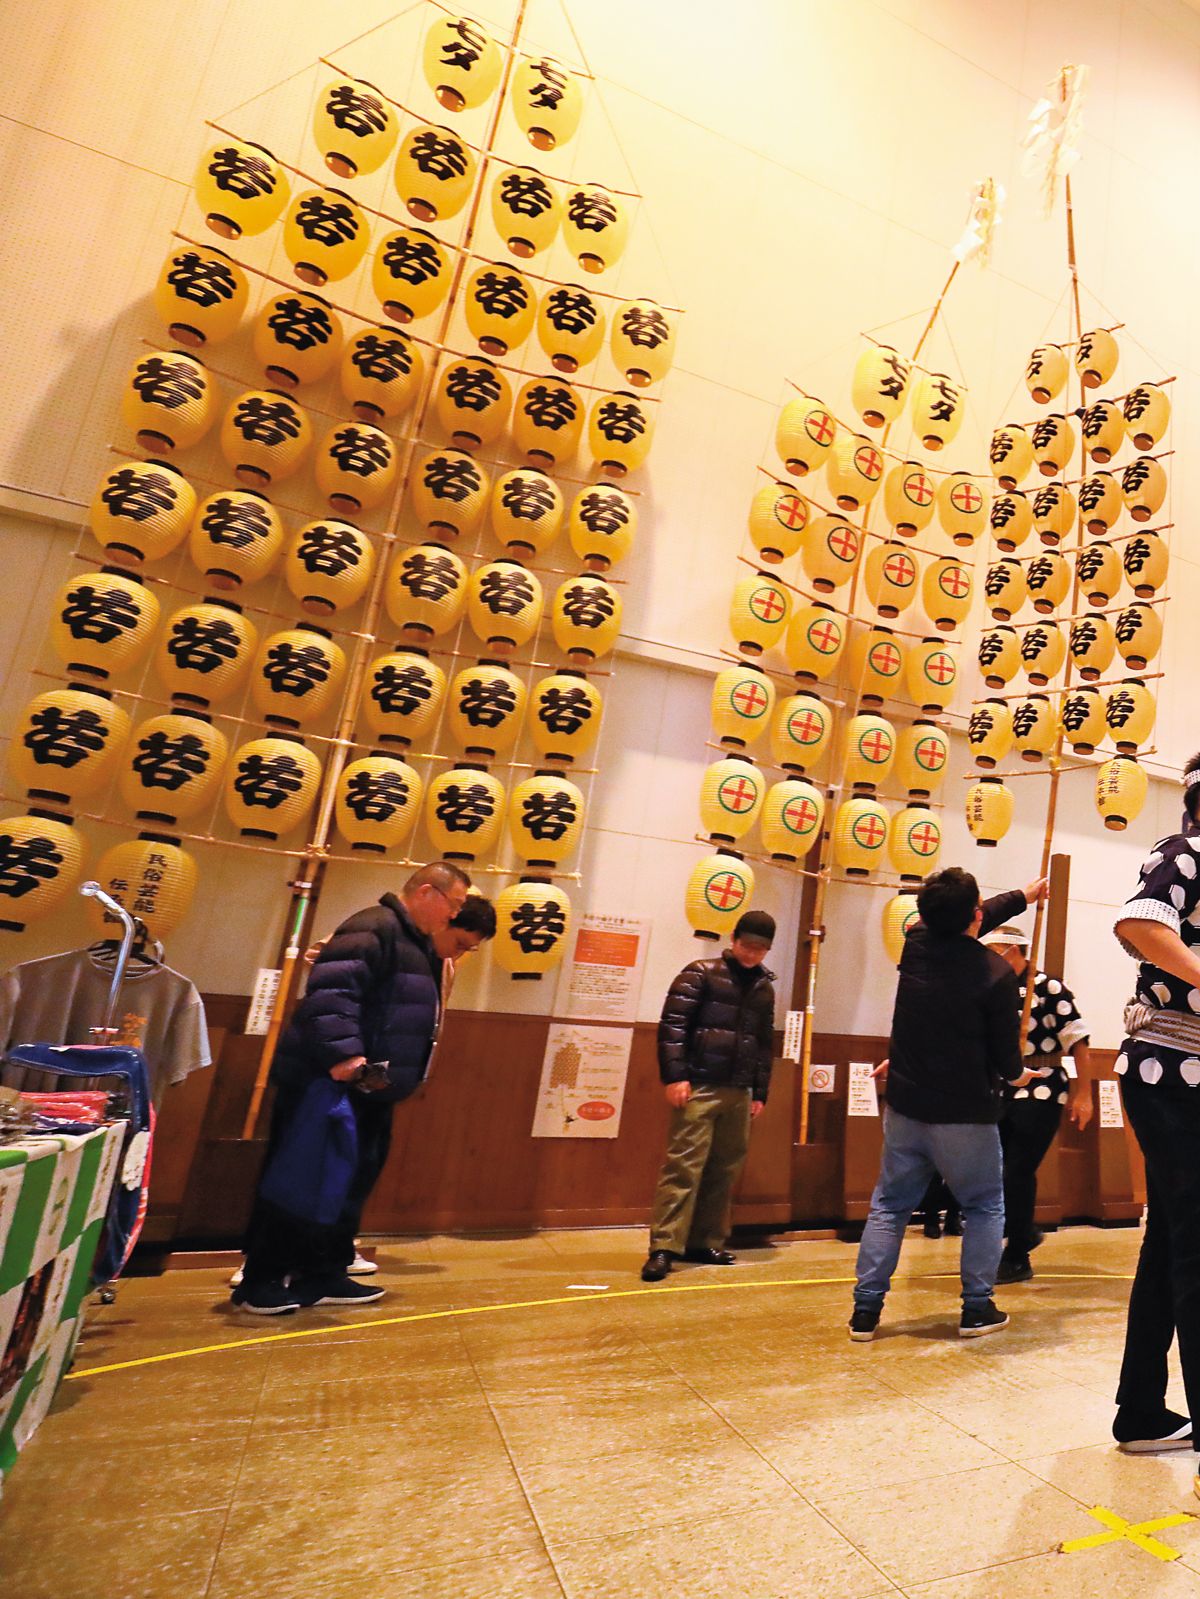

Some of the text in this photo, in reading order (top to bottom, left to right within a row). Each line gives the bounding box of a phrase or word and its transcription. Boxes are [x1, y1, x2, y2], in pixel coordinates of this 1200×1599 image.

[440, 18, 486, 71] 七夕
[529, 59, 566, 110] 七夕
[327, 86, 387, 137] 若
[208, 148, 276, 198] 若
[411, 133, 467, 180] 若
[501, 175, 551, 218] 若
[569, 193, 616, 232] 若
[295, 196, 359, 246] 若
[167, 252, 237, 305] 若
[383, 237, 441, 285] 若
[475, 273, 527, 318] 若
[547, 290, 596, 334] 若
[268, 298, 332, 350] 若
[622, 310, 667, 349] 若
[133, 358, 205, 408] 若
[352, 336, 412, 383] 若
[879, 355, 908, 400] 七夕
[447, 367, 501, 412] 若
[525, 386, 576, 430] 若
[929, 380, 957, 421] 七夕
[234, 398, 301, 446] 若
[598, 402, 645, 443] 若
[330, 428, 390, 477] 若
[102, 470, 177, 521] 若
[424, 458, 480, 502] 若
[503, 478, 554, 520] 若
[202, 499, 271, 548] 若
[580, 494, 628, 534] 若
[298, 527, 361, 576] 若
[400, 555, 459, 601] 若
[480, 572, 533, 615] 若
[62, 586, 140, 644] 若
[563, 587, 613, 628] 若
[168, 617, 240, 673] 若
[263, 643, 330, 697] 若
[371, 666, 432, 716] 若
[460, 680, 516, 728] 若
[539, 689, 592, 735] 若
[24, 707, 109, 768] 若
[132, 732, 209, 791] 若
[234, 755, 304, 809] 若
[345, 772, 408, 822] 若
[436, 785, 494, 833] 若
[522, 793, 576, 841] 若
[510, 901, 565, 953] 若
